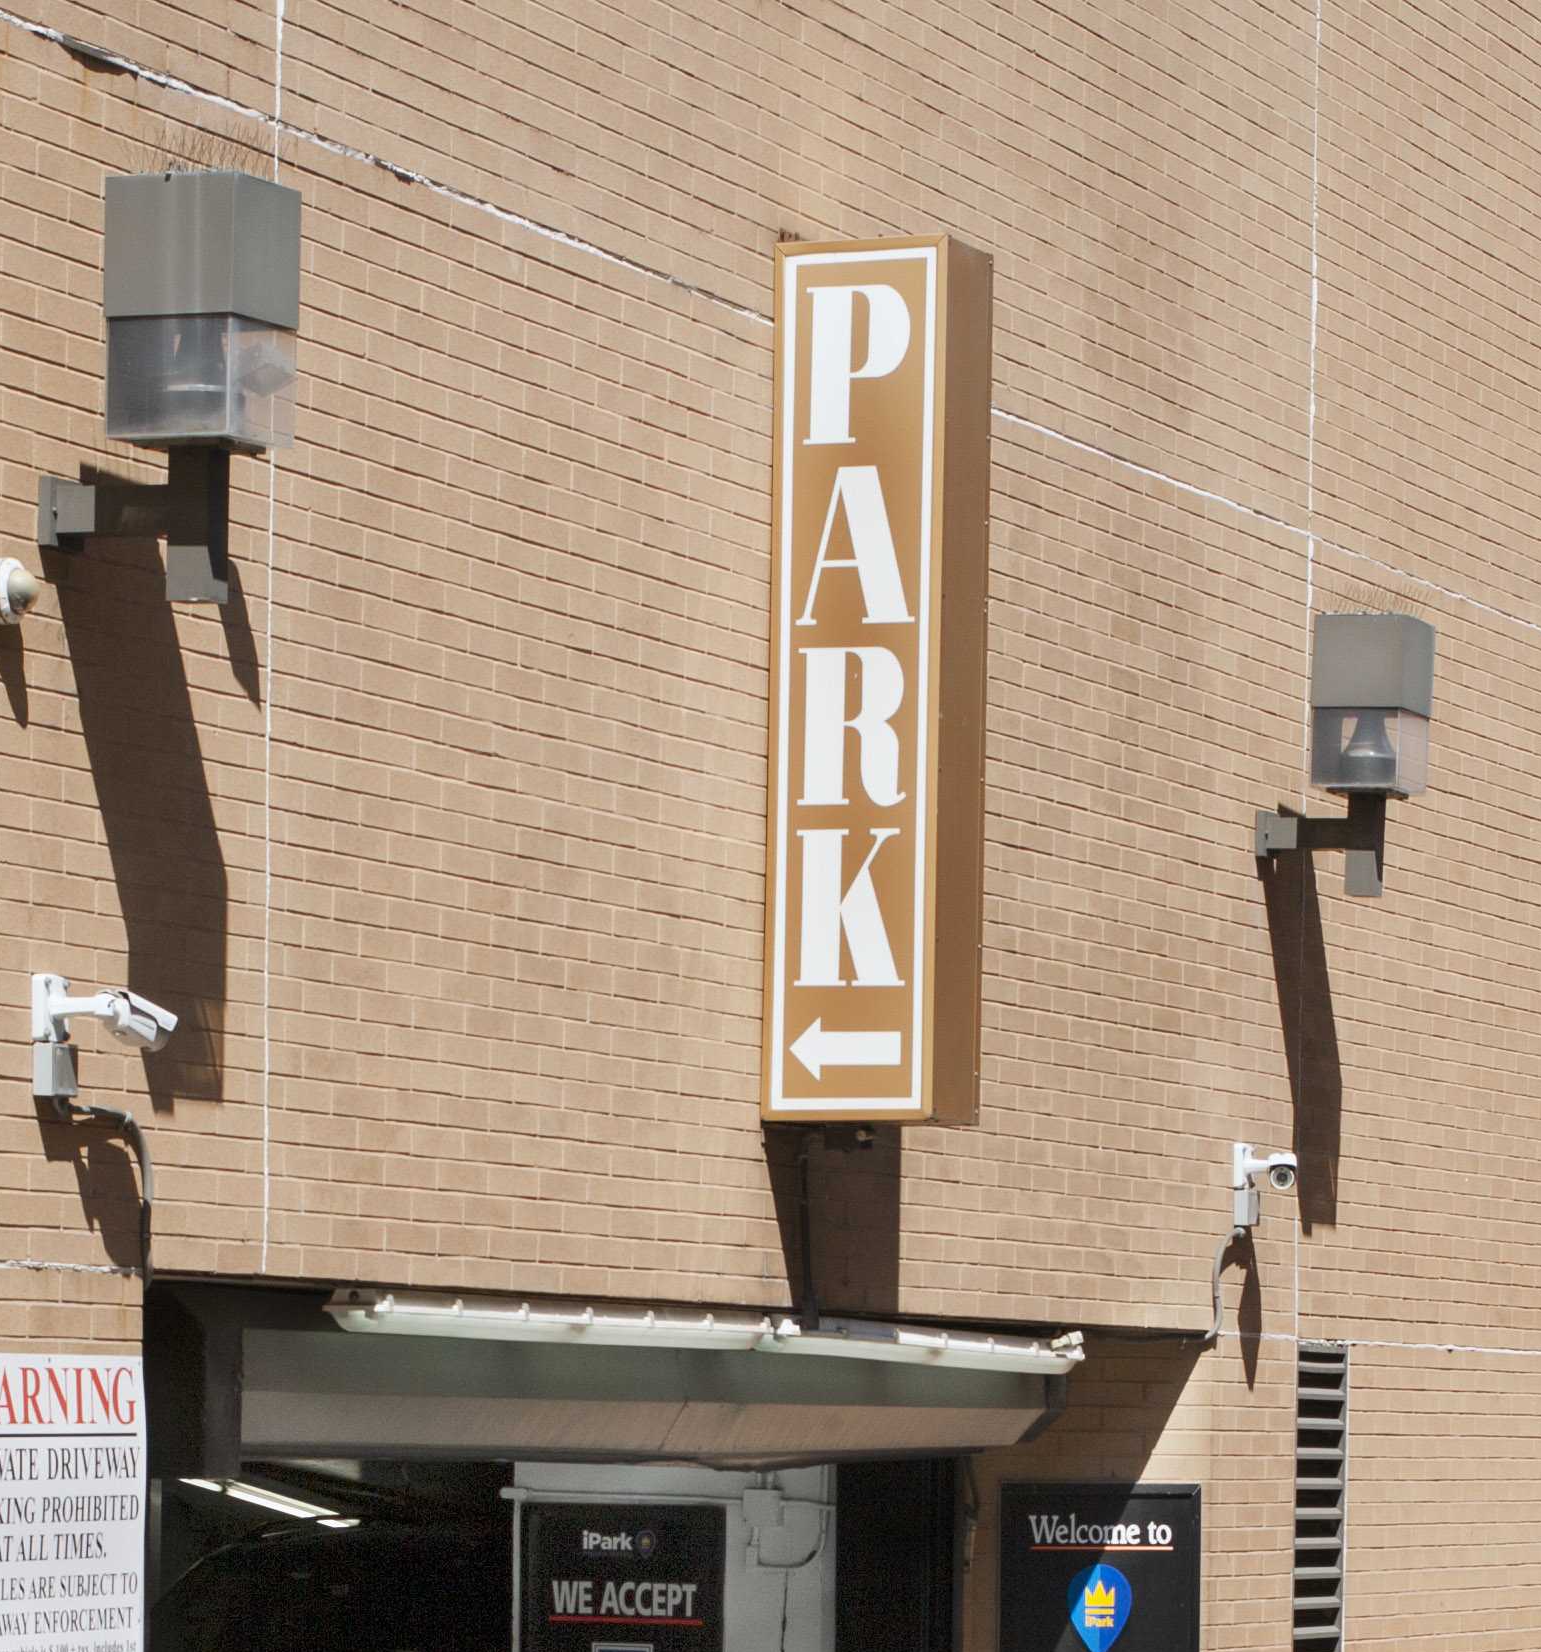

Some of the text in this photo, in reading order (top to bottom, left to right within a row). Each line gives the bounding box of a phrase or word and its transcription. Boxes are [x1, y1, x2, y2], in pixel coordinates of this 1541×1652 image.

[793, 282, 916, 988] PARK
[48, 1447, 140, 1480] DRIVEWAY
[42, 1495, 138, 1523] PROHIBITED
[582, 1529, 633, 1551] iPark
[1029, 1513, 1172, 1545] Welcome to
[16, 1534, 48, 1562] ALL
[54, 1532, 106, 1560] TIMES.
[29, 1576, 55, 1599] ARE
[60, 1574, 118, 1597] SUBJECT
[122, 1572, 137, 1594] TO
[552, 1580, 697, 1617] WE ACCEPT
[34, 1607, 134, 1634] ENFORCEMENT
